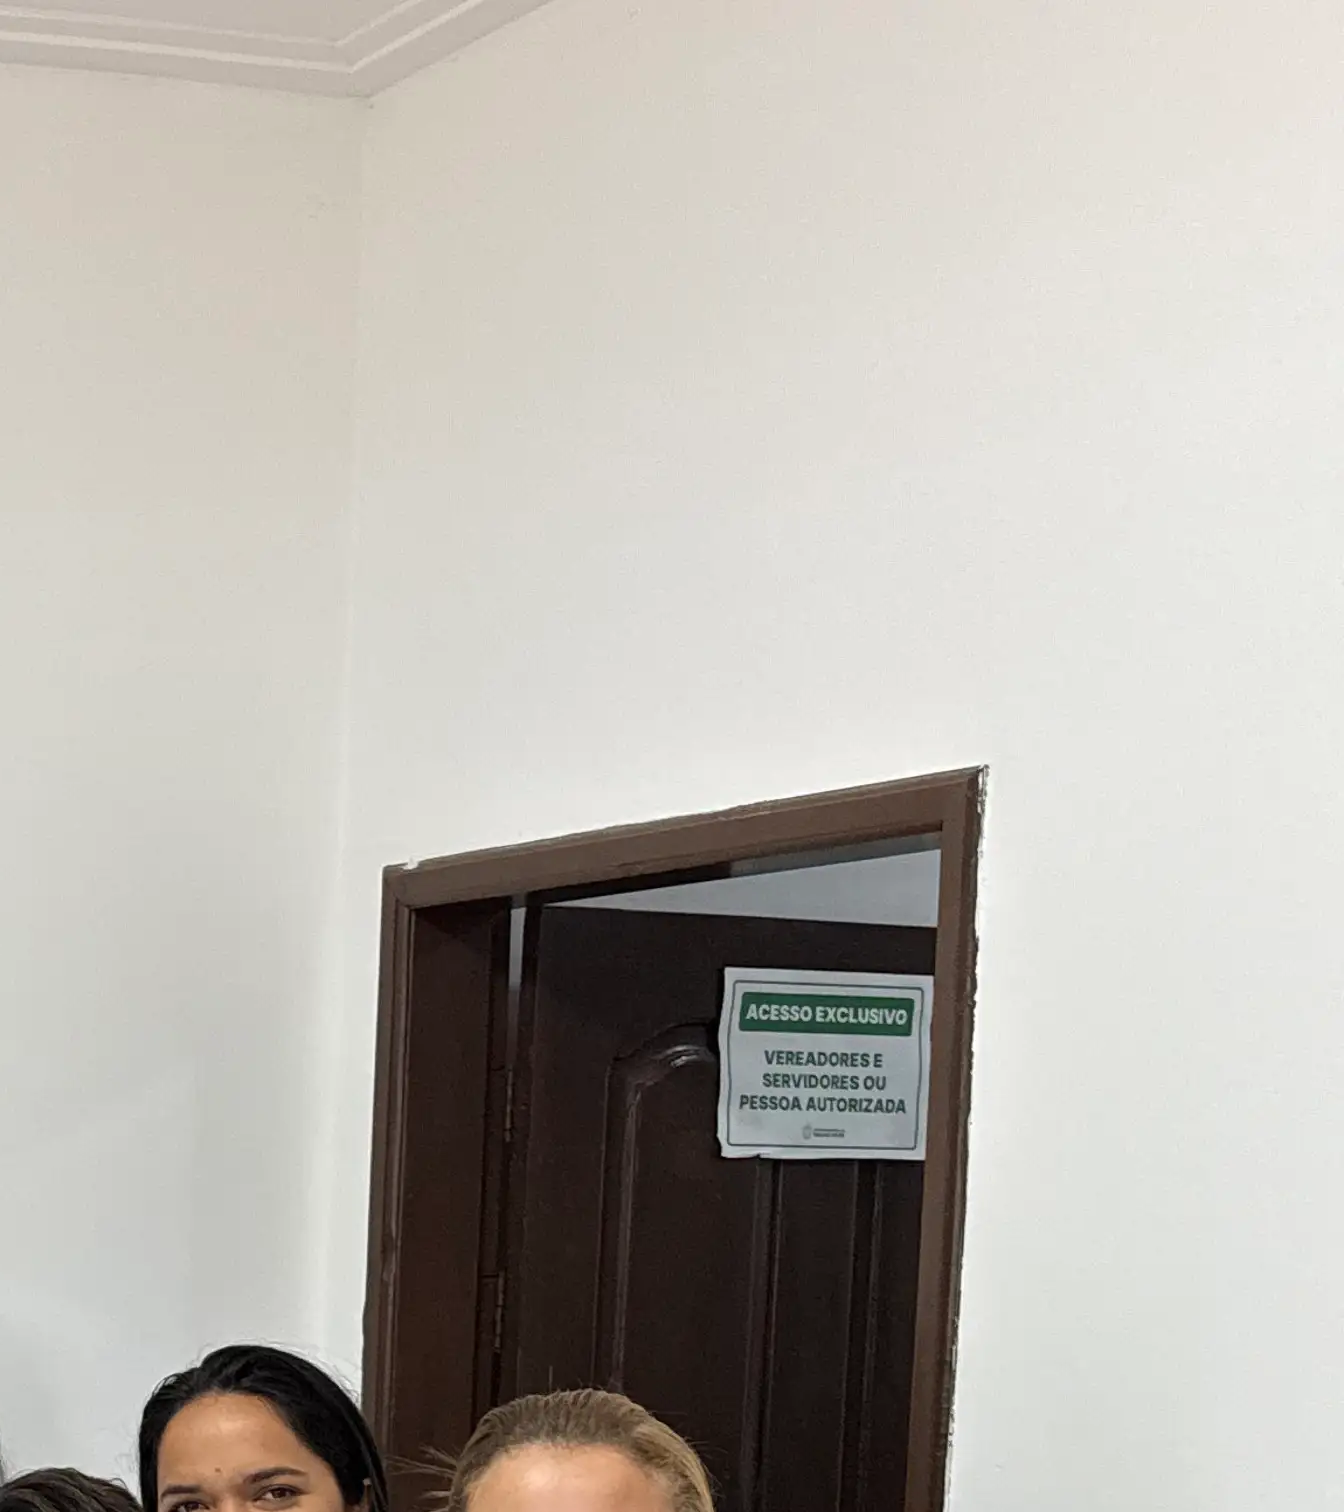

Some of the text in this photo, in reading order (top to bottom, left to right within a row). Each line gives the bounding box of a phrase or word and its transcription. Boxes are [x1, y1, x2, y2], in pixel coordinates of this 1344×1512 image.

[746, 1004, 908, 1026] ACESSO EXCLUSIVO
[764, 1050, 883, 1068] VEREADORES E
[762, 1073, 887, 1090] SERVIDORES OU
[739, 1094, 907, 1114] PESSOA AUTORIZADA
